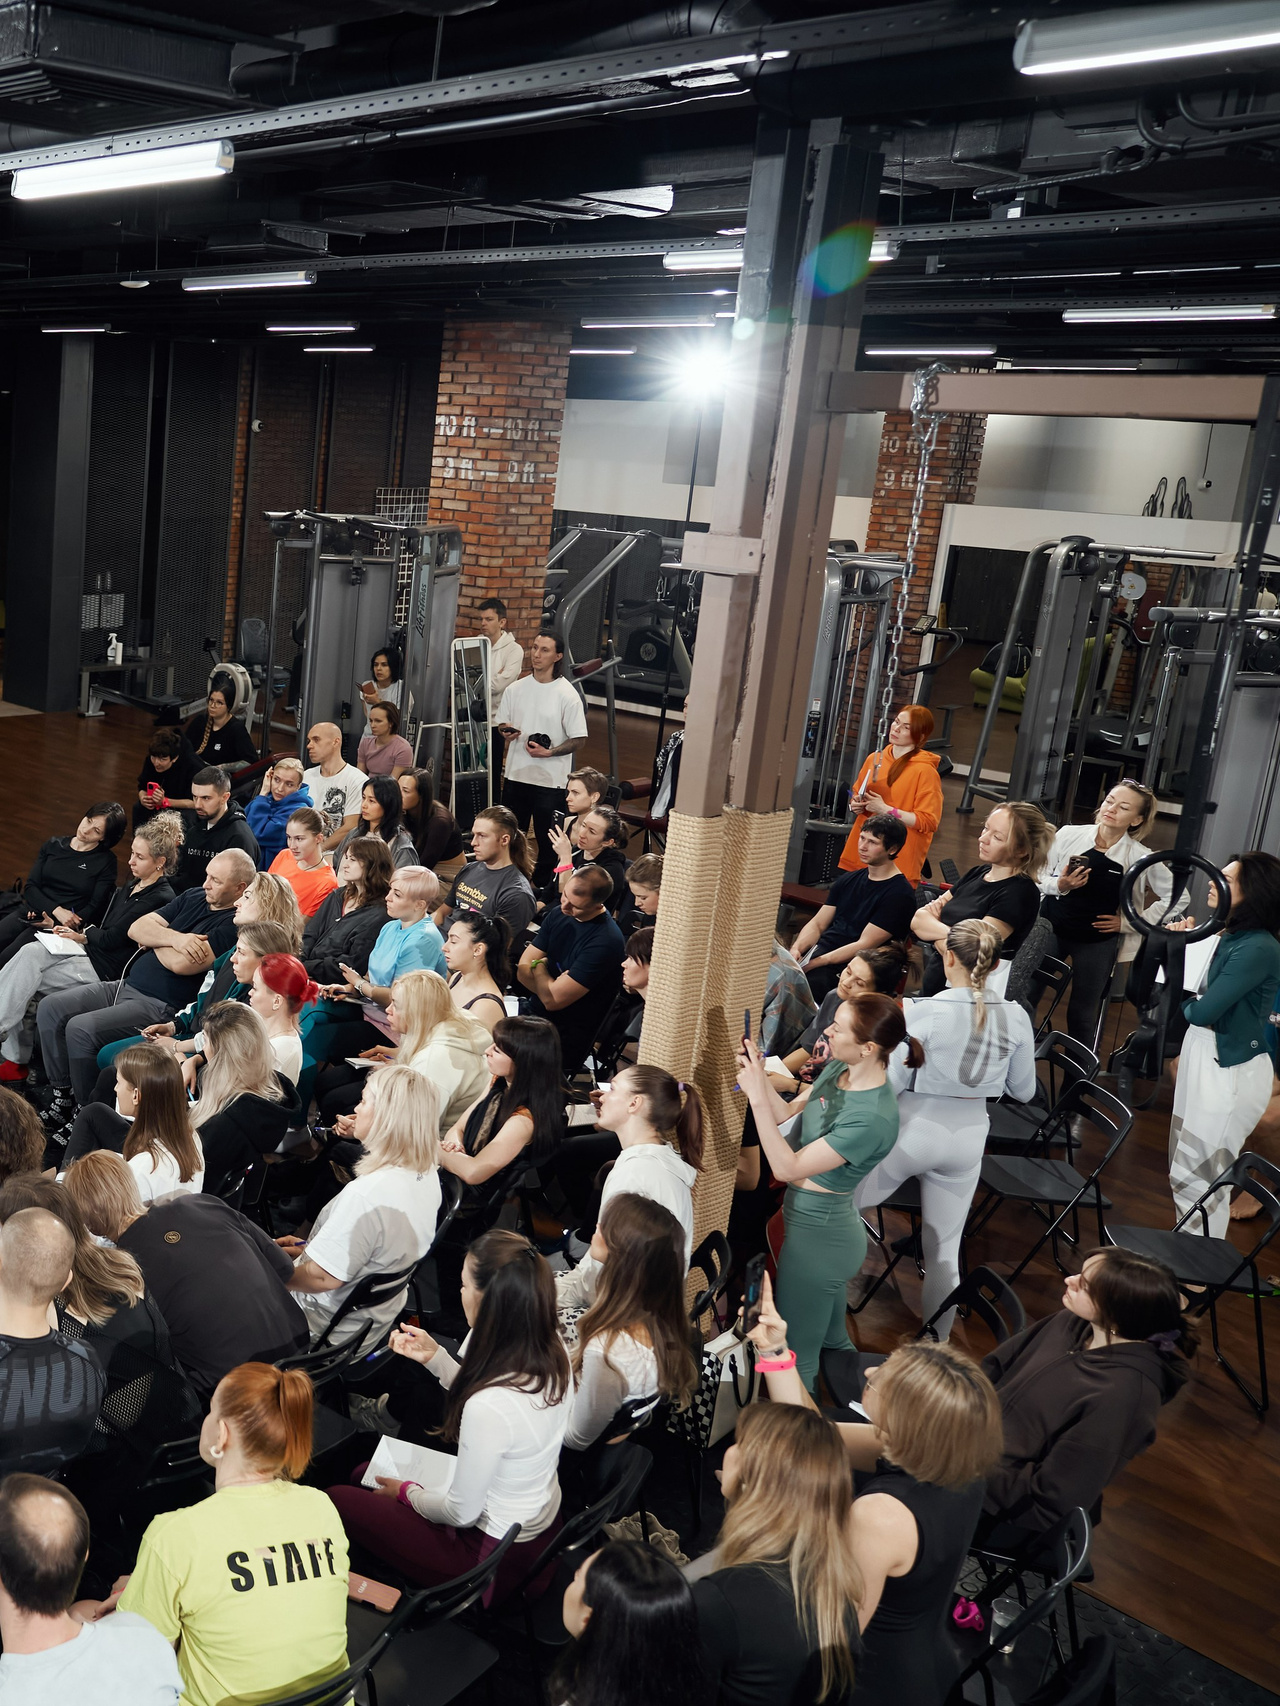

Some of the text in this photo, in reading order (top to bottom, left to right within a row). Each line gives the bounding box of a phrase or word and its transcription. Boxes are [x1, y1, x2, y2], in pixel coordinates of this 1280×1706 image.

[435, 415, 476, 437] 10 ft
[504, 418, 539, 440] 10 ft
[881, 436, 900, 453] 10
[443, 457, 473, 480] 9 ft
[523, 462, 535, 483] ft
[883, 469, 916, 488] 9 ft
